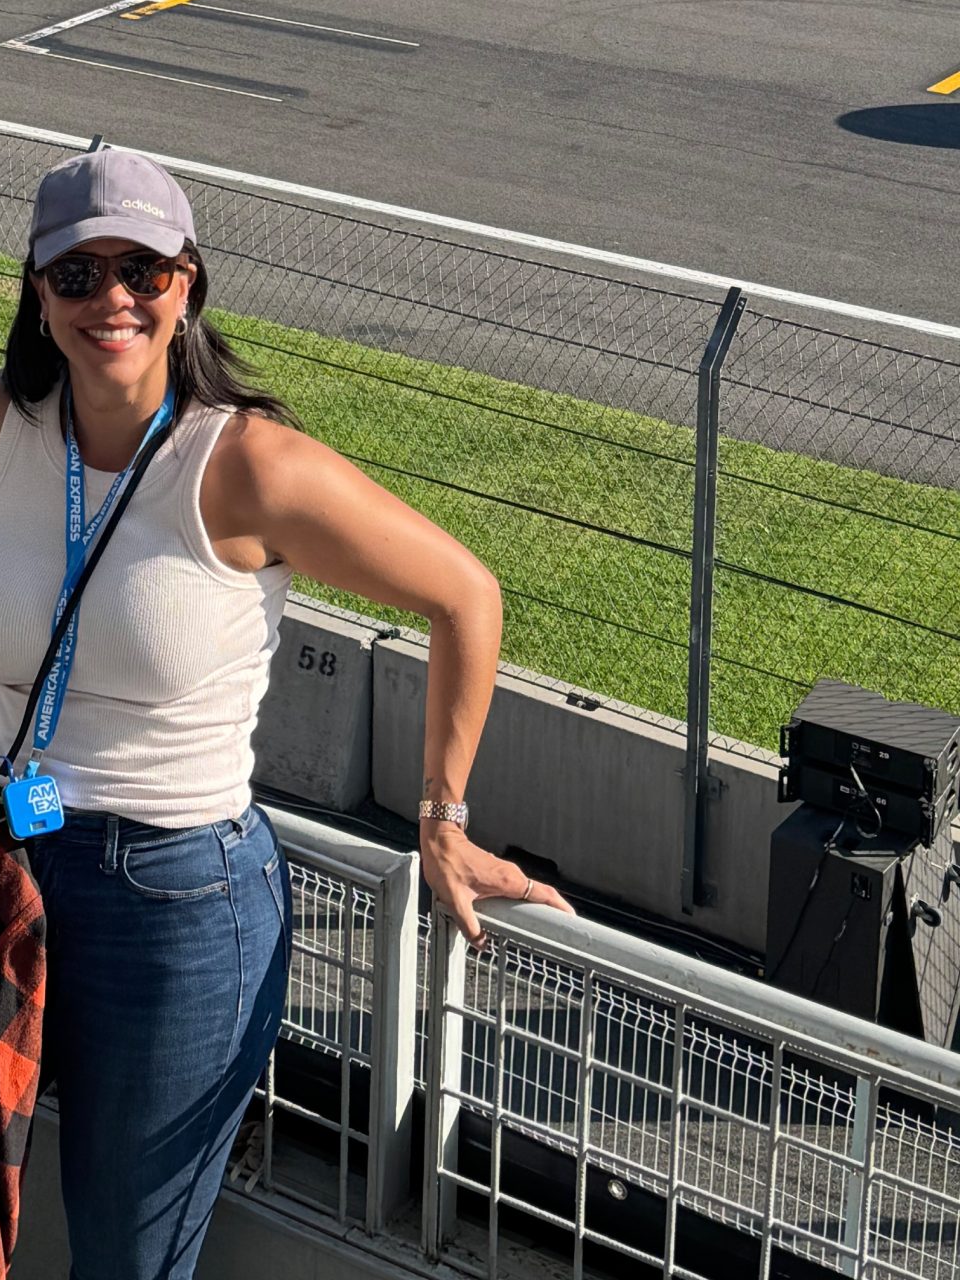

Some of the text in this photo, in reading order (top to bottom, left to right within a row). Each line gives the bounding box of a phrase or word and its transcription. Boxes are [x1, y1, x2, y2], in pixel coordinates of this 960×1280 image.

[121, 198, 166, 219] adidas
[70, 476, 81, 542] EXPRESS
[298, 645, 337, 677] 58
[37, 661, 62, 741] AMERICAN
